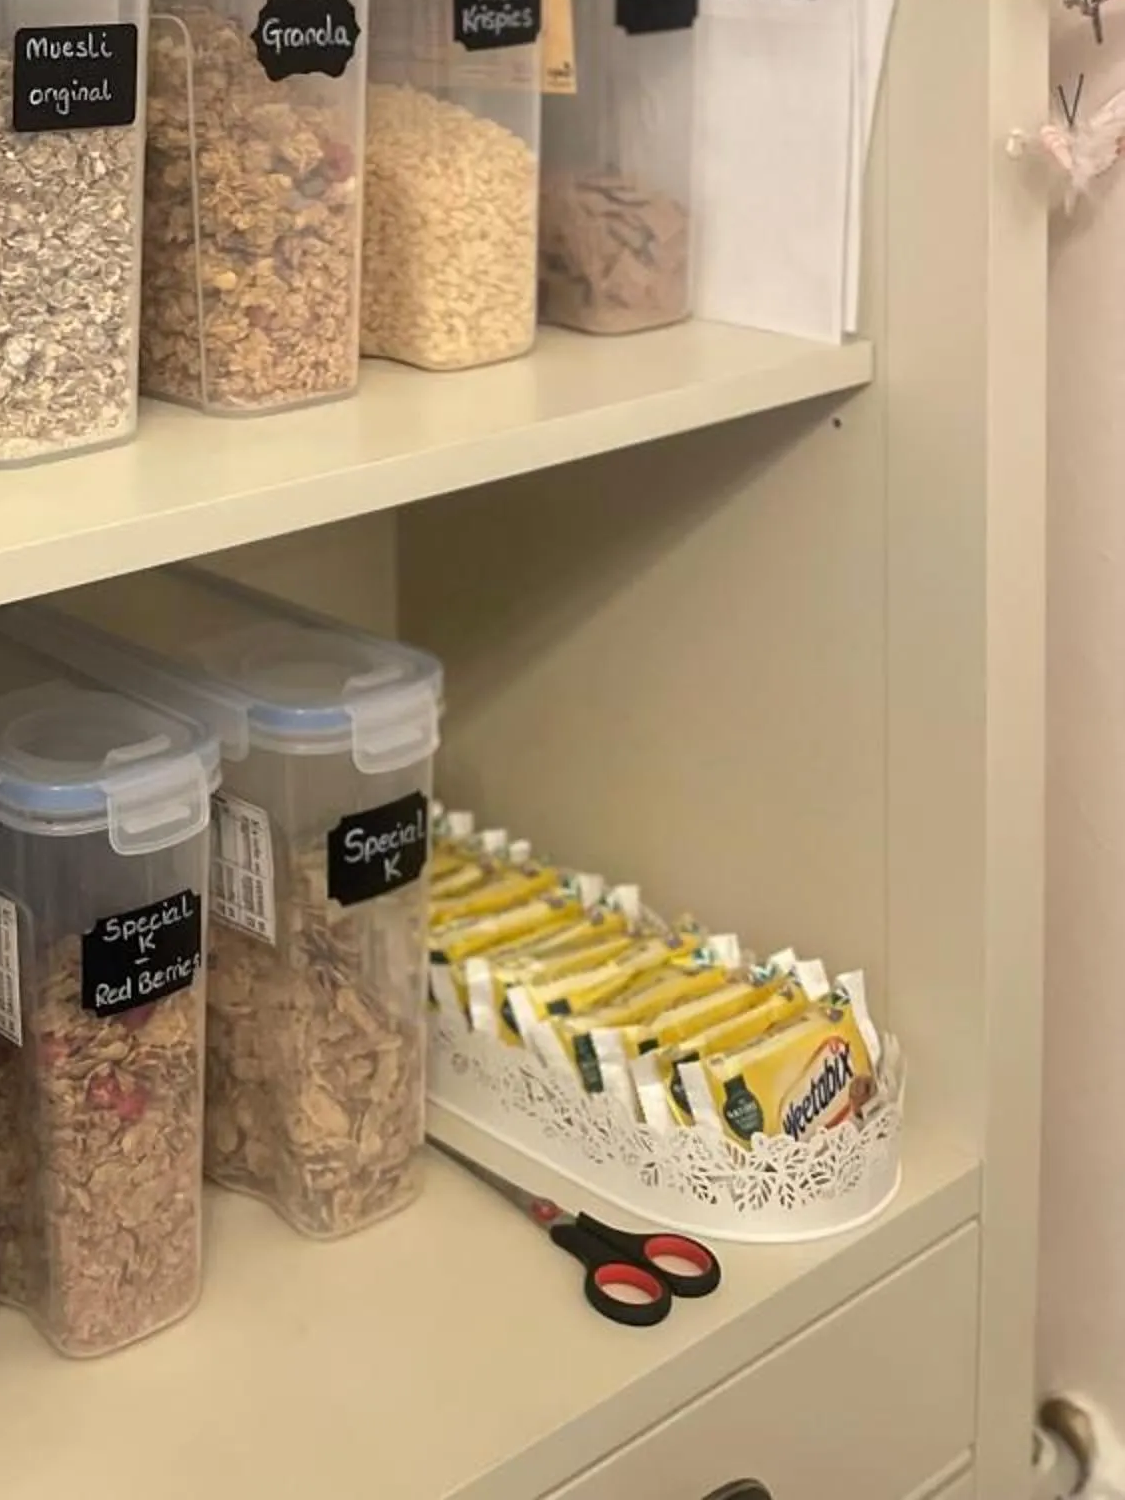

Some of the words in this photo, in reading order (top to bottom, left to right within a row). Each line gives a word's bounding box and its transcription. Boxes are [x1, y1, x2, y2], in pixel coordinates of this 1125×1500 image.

[262, 13, 352, 55] Granola
[462, 3, 533, 36] Krispies
[26, 31, 113, 61] Muesli
[29, 78, 113, 115] original
[343, 808, 426, 865] Special
[383, 850, 403, 884] K
[102, 894, 194, 942] Special
[139, 931, 156, 954] K
[95, 976, 133, 1008] Red
[782, 1042, 854, 1142] Weetabix
